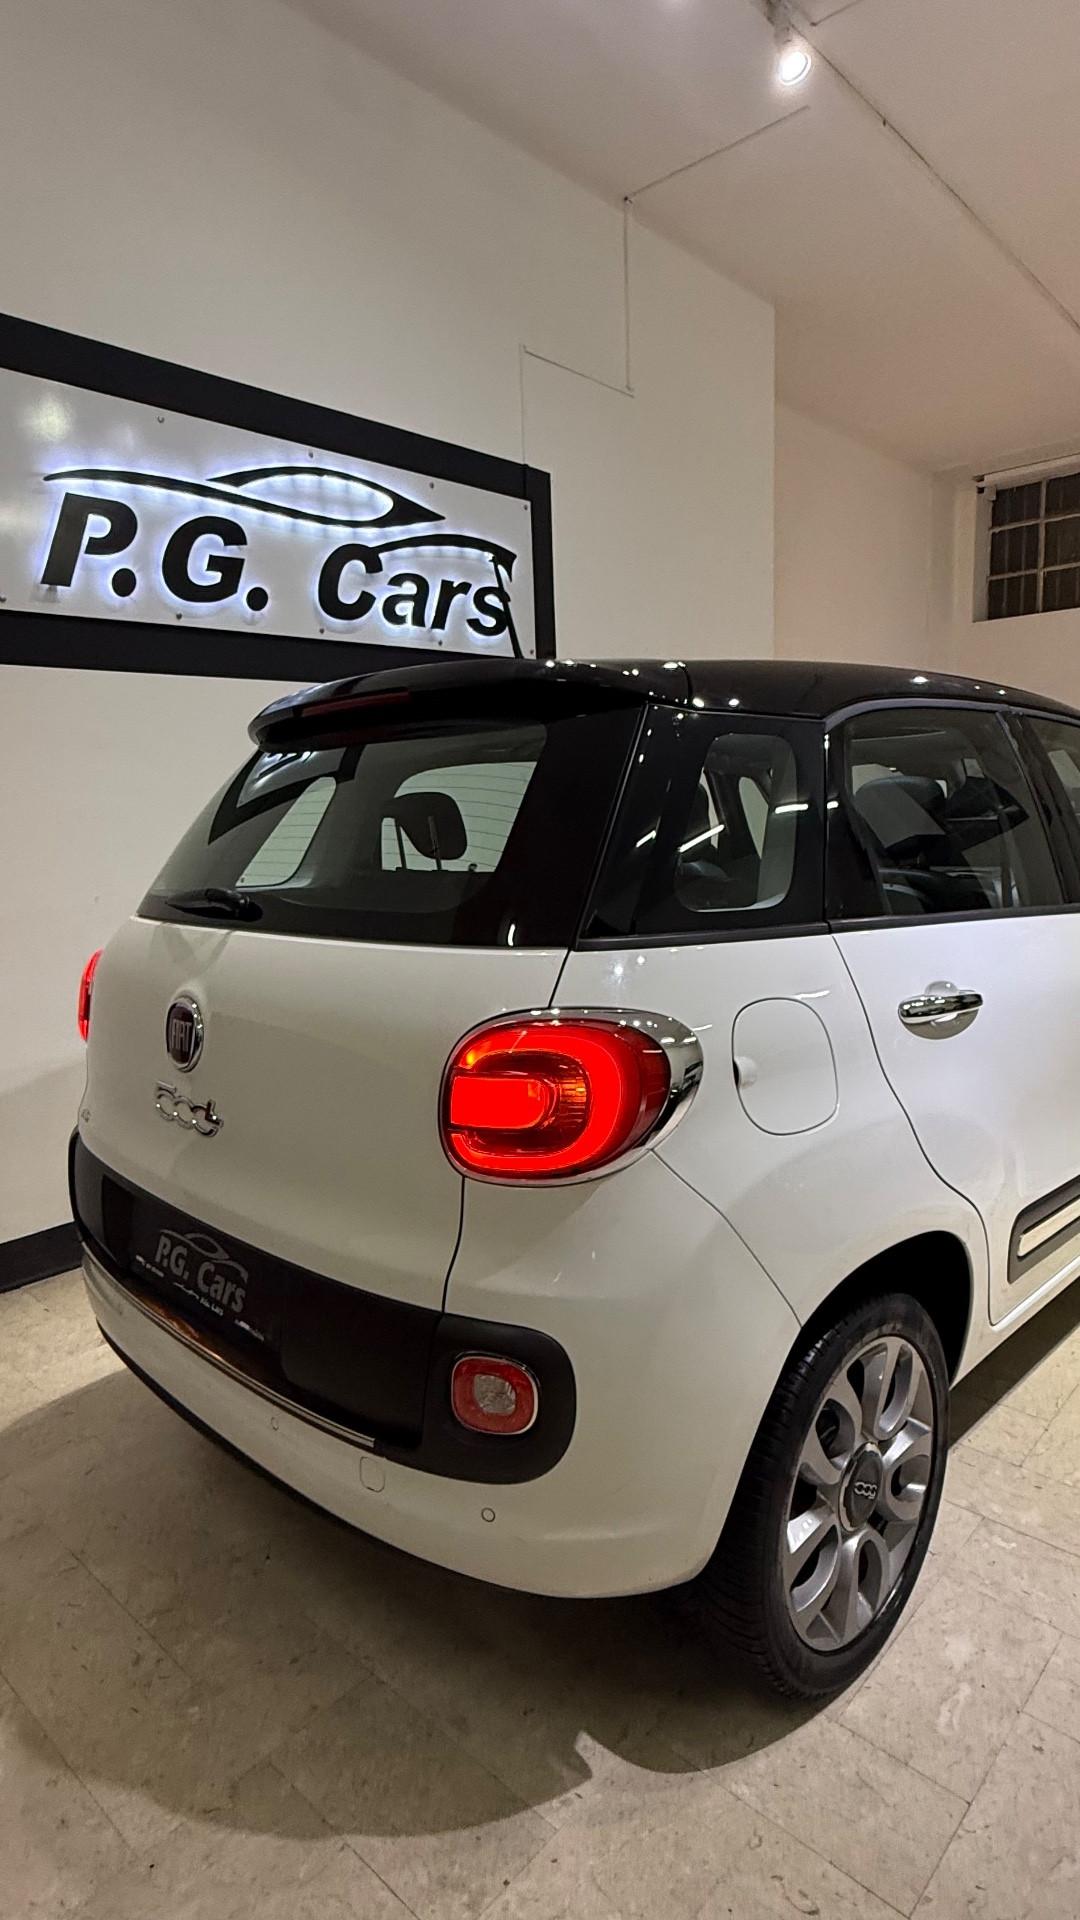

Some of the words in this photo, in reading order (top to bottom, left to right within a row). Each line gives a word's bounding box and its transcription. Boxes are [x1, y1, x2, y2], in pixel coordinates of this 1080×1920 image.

[40, 492, 269, 611] P.G.
[318, 543, 511, 636] Cars
[170, 1017, 193, 1051] FIAT
[154, 1235, 190, 1280] P.G.
[197, 1261, 247, 1313] Cars
